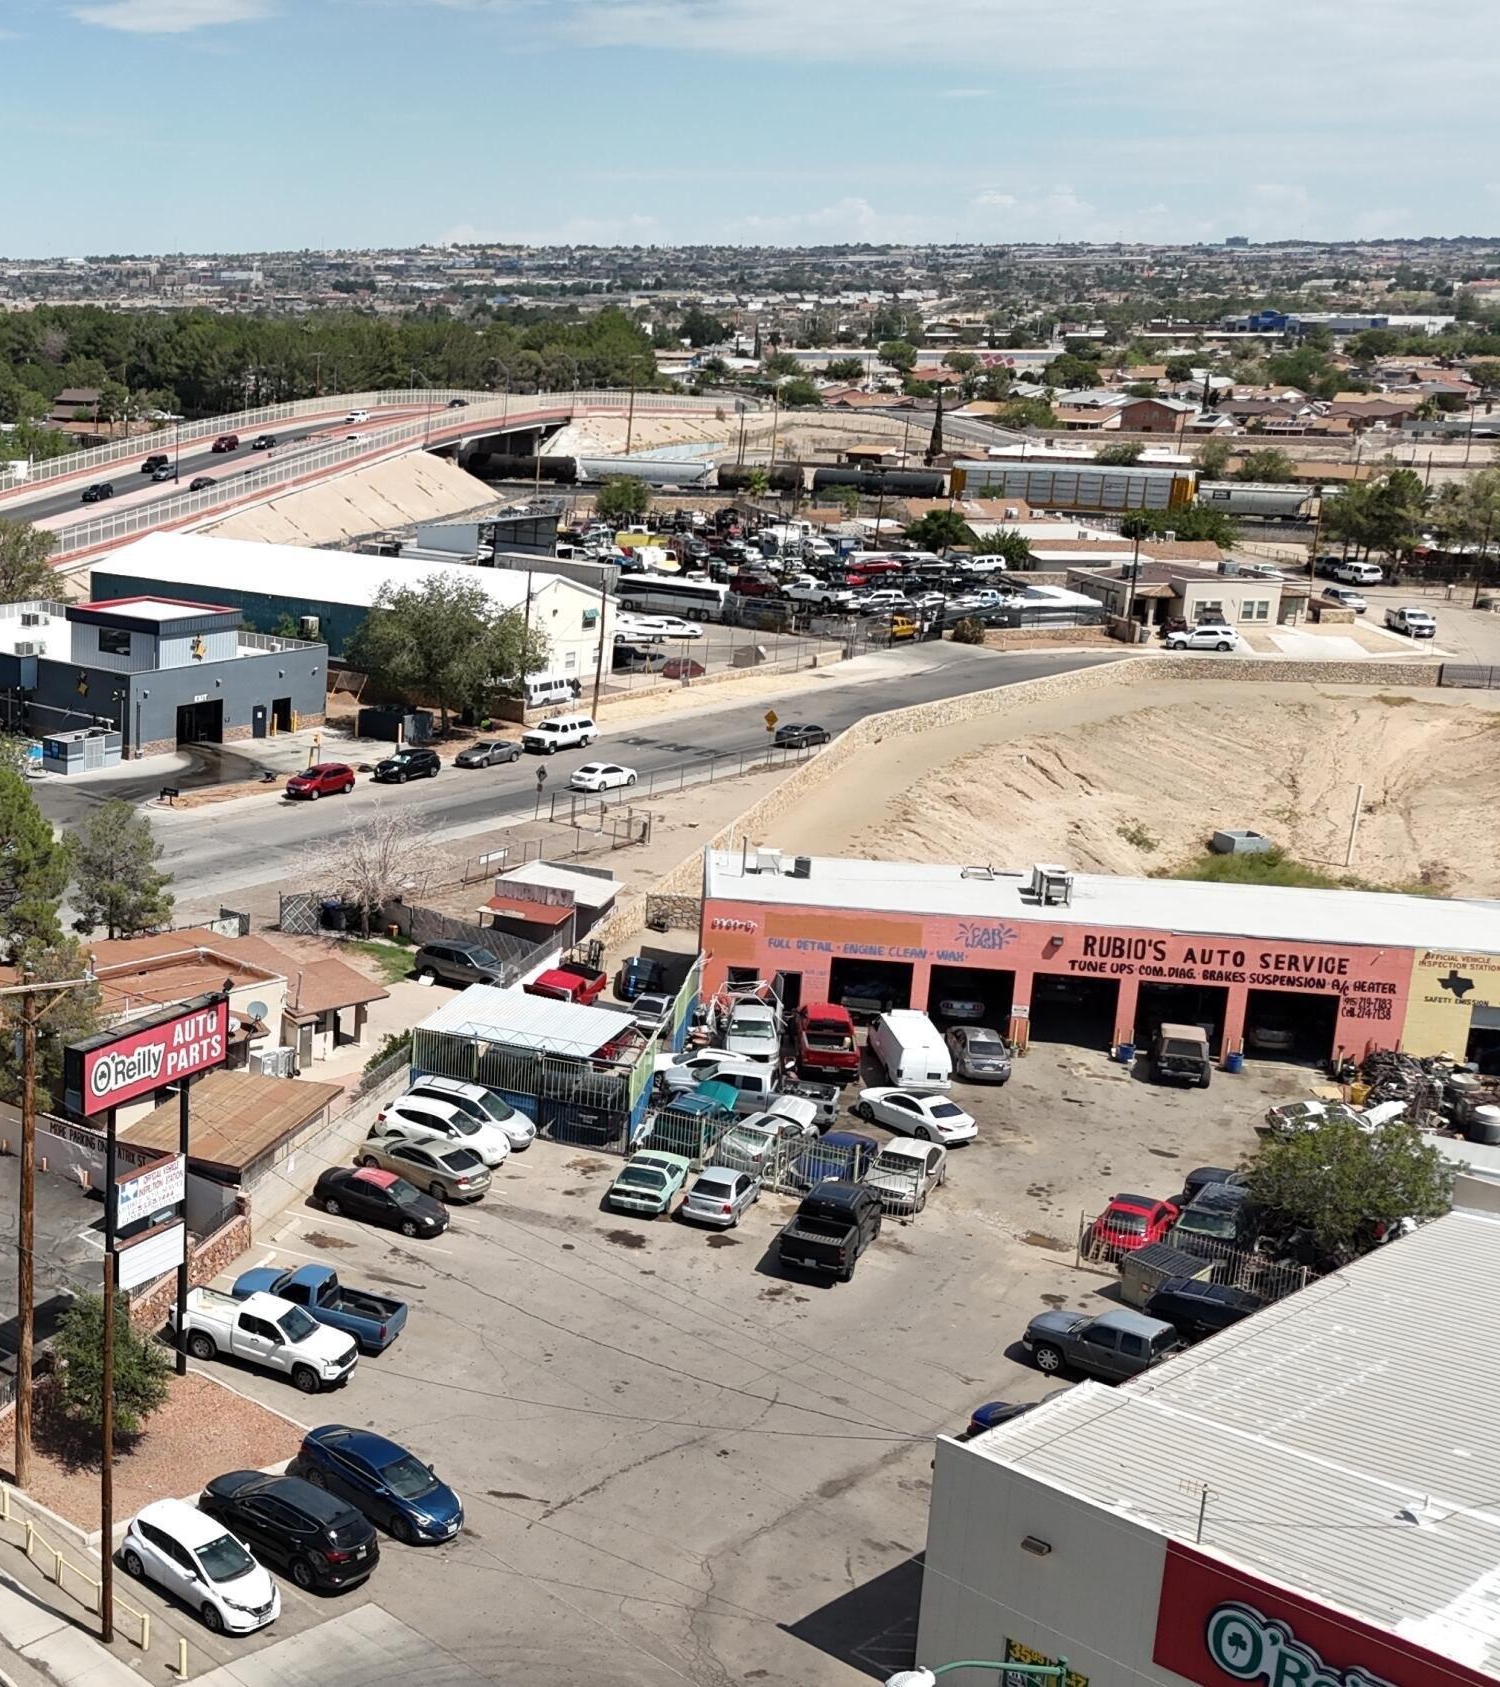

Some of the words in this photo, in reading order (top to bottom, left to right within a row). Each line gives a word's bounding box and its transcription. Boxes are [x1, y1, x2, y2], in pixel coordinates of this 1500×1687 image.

[965, 936, 1003, 949] WASH
[972, 927, 1002, 939] CAR
[768, 937, 791, 949] FULL
[796, 940, 834, 952] DETAIL
[843, 944, 884, 956] ENGINE
[888, 946, 928, 959] CLEAN
[936, 951, 965, 962] WAX
[1083, 935, 1167, 962] RUBIO'S
[1183, 948, 1245, 967] AUTO
[1259, 953, 1350, 975] SERVICE
[1425, 953, 1459, 962] OFFICIAL
[1461, 955, 1491, 964] VEHICLE
[1419, 960, 1467, 969] INSPECTION
[1068, 959, 1107, 972] TUNE
[1110, 963, 1135, 975] UPS
[1202, 969, 1246, 983] BRAKES
[1249, 972, 1326, 989] SUSPENSION
[1331, 978, 1350, 997] A/C
[1352, 980, 1397, 995] HEATER
[1424, 996, 1452, 1004] SAFETY
[173, 1011, 217, 1047] AUTO
[166, 1034, 222, 1076] PARTS
[92, 1044, 165, 1095] O'Reilly
[50, 1123, 67, 1140] MORE
[69, 1128, 96, 1150] PARKING
